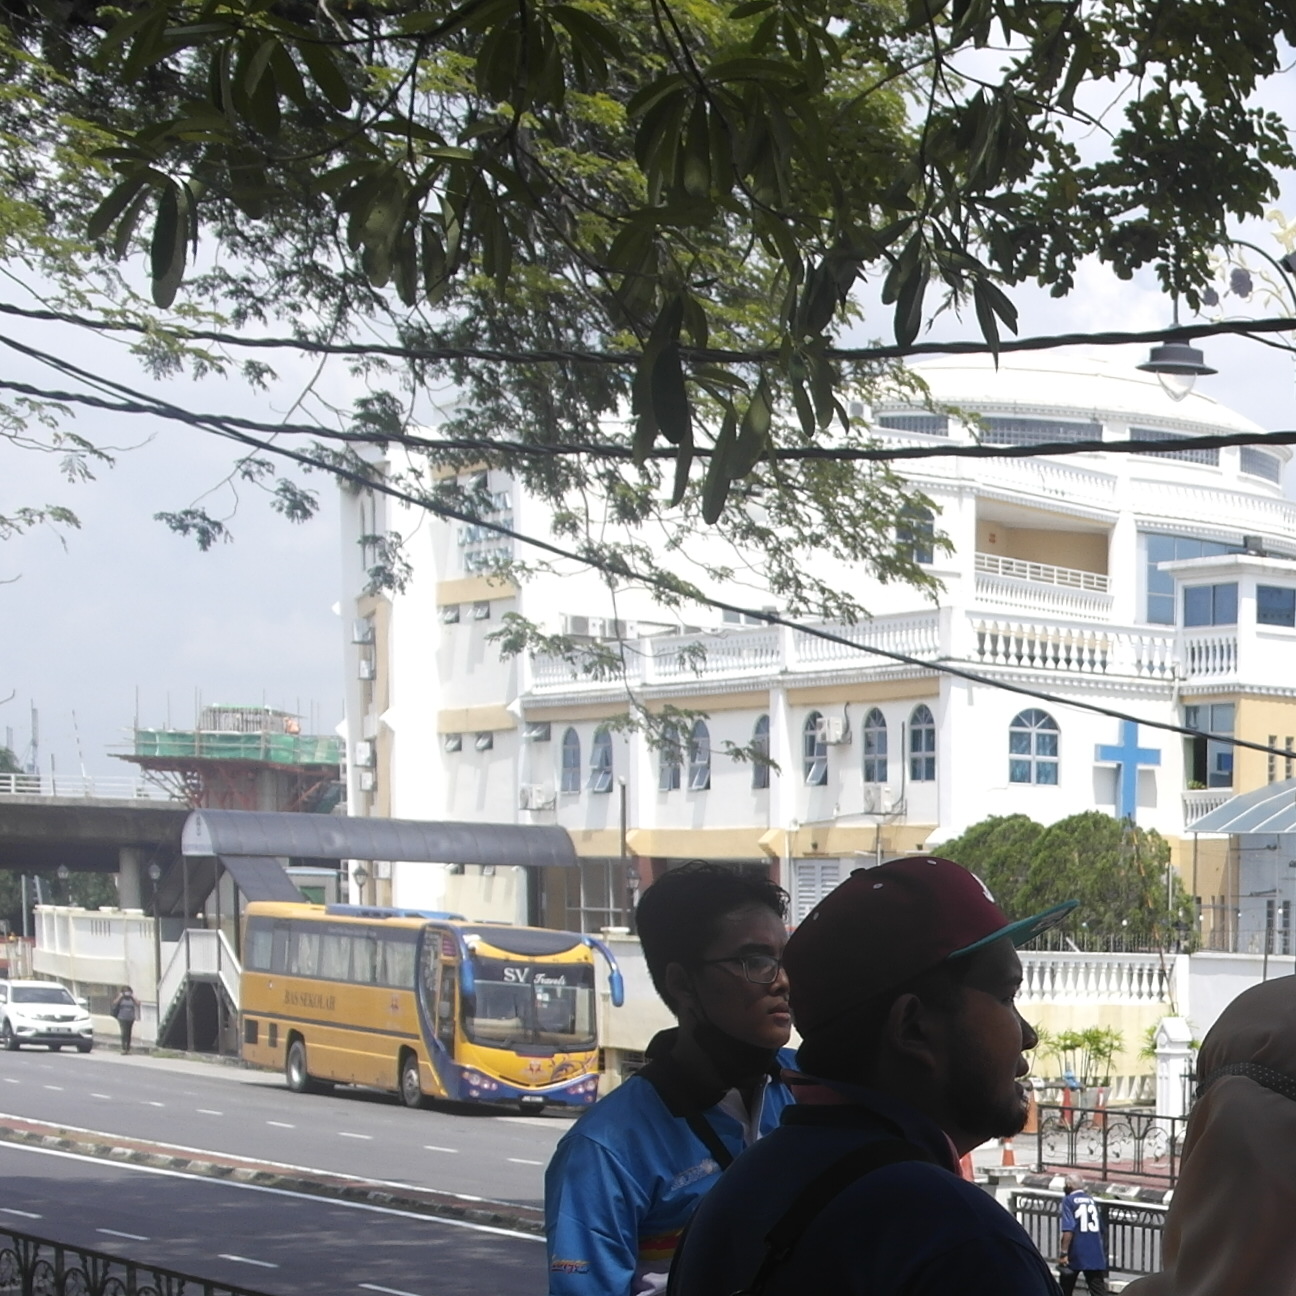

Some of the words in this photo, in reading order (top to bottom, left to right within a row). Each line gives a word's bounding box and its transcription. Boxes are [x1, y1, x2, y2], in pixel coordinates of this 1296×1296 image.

[503, 966, 529, 983] SV
[533, 973, 566, 986] Travels
[1074, 1203, 1100, 1233] 13
